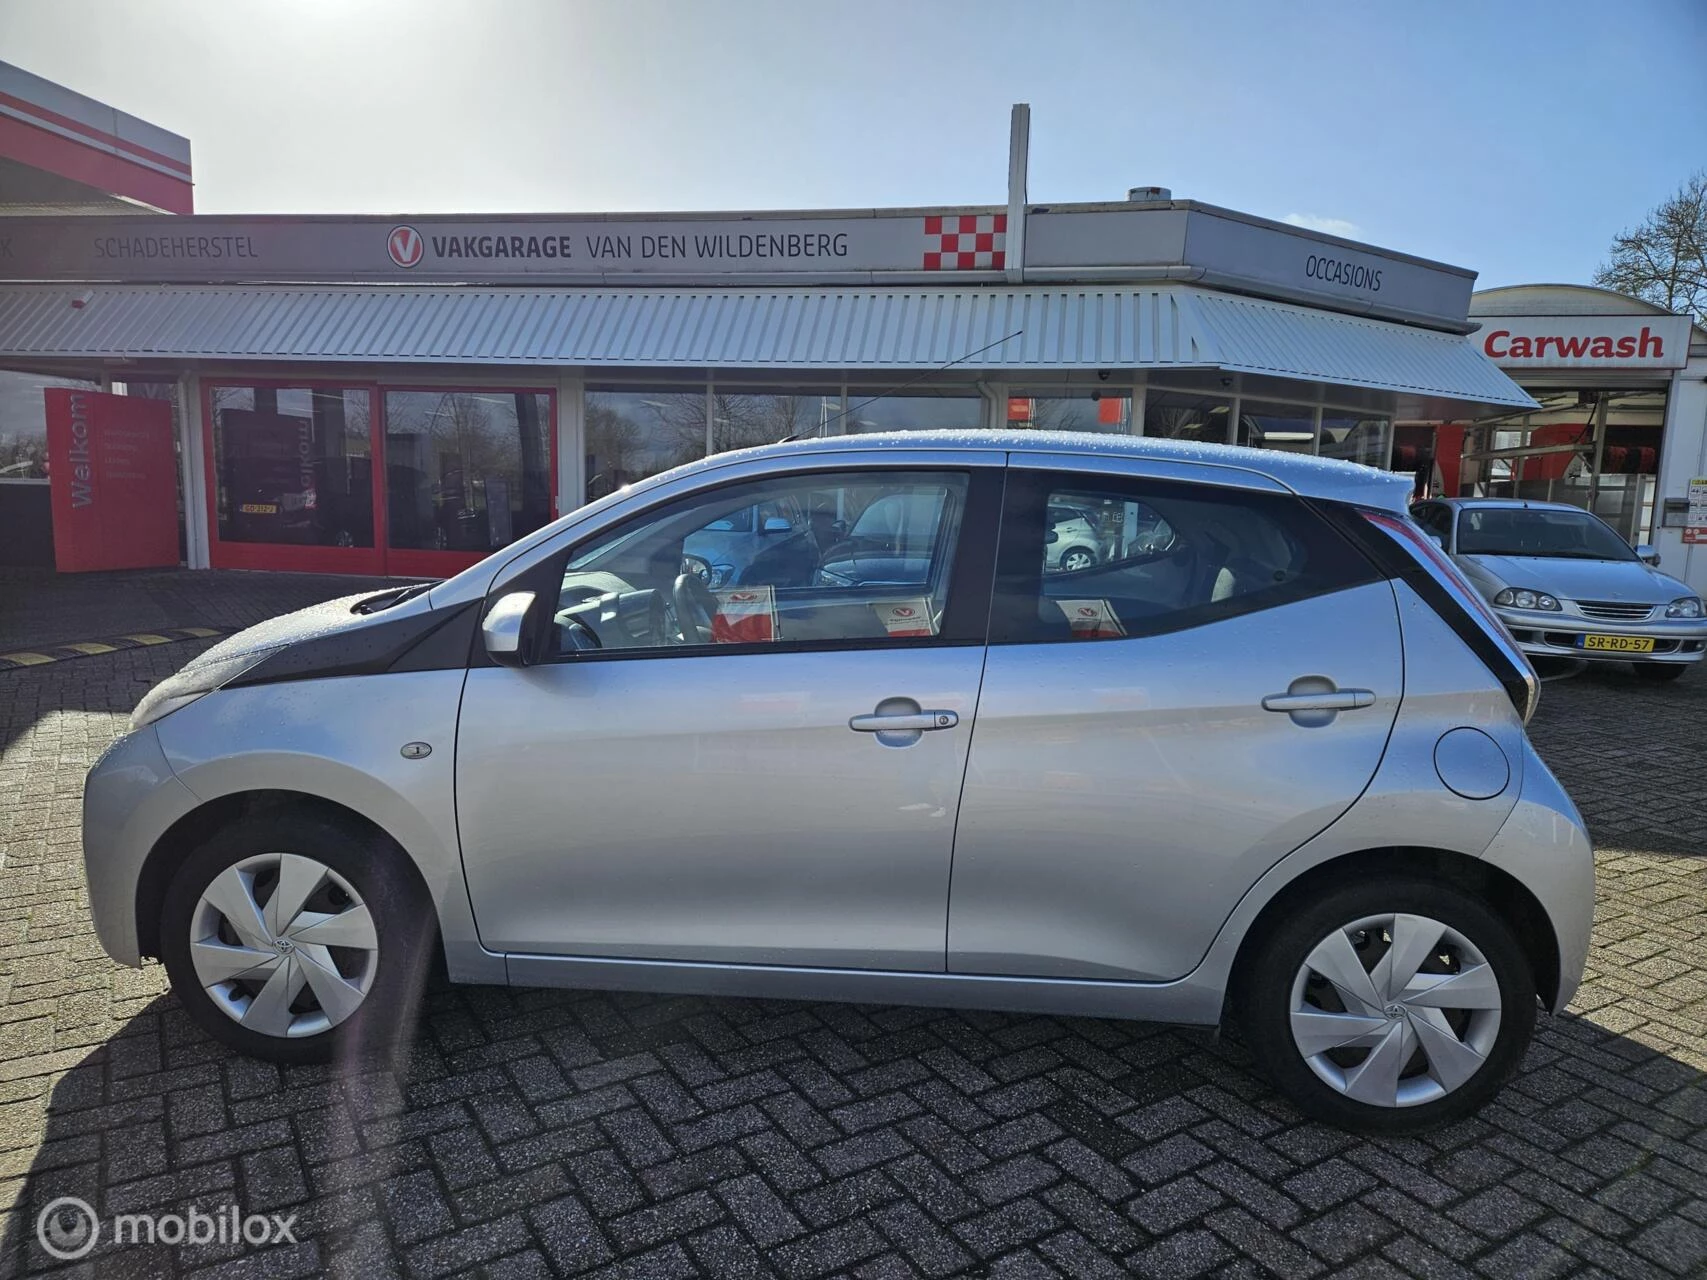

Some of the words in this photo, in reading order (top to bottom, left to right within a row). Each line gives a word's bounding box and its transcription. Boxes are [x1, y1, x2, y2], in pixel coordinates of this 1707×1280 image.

[94, 236, 259, 259] SCHADEHERSTEL
[431, 235, 572, 258] VAKGARAGE
[586, 235, 632, 259] VAN
[641, 235, 686, 258] DEN
[694, 233, 848, 258] WILDENBERG
[1305, 254, 1382, 292] OCCASIONS
[1483, 326, 1664, 359] Carwash
[70, 394, 92, 510] Welkom
[1588, 636, 1650, 650] SR-RD-57
